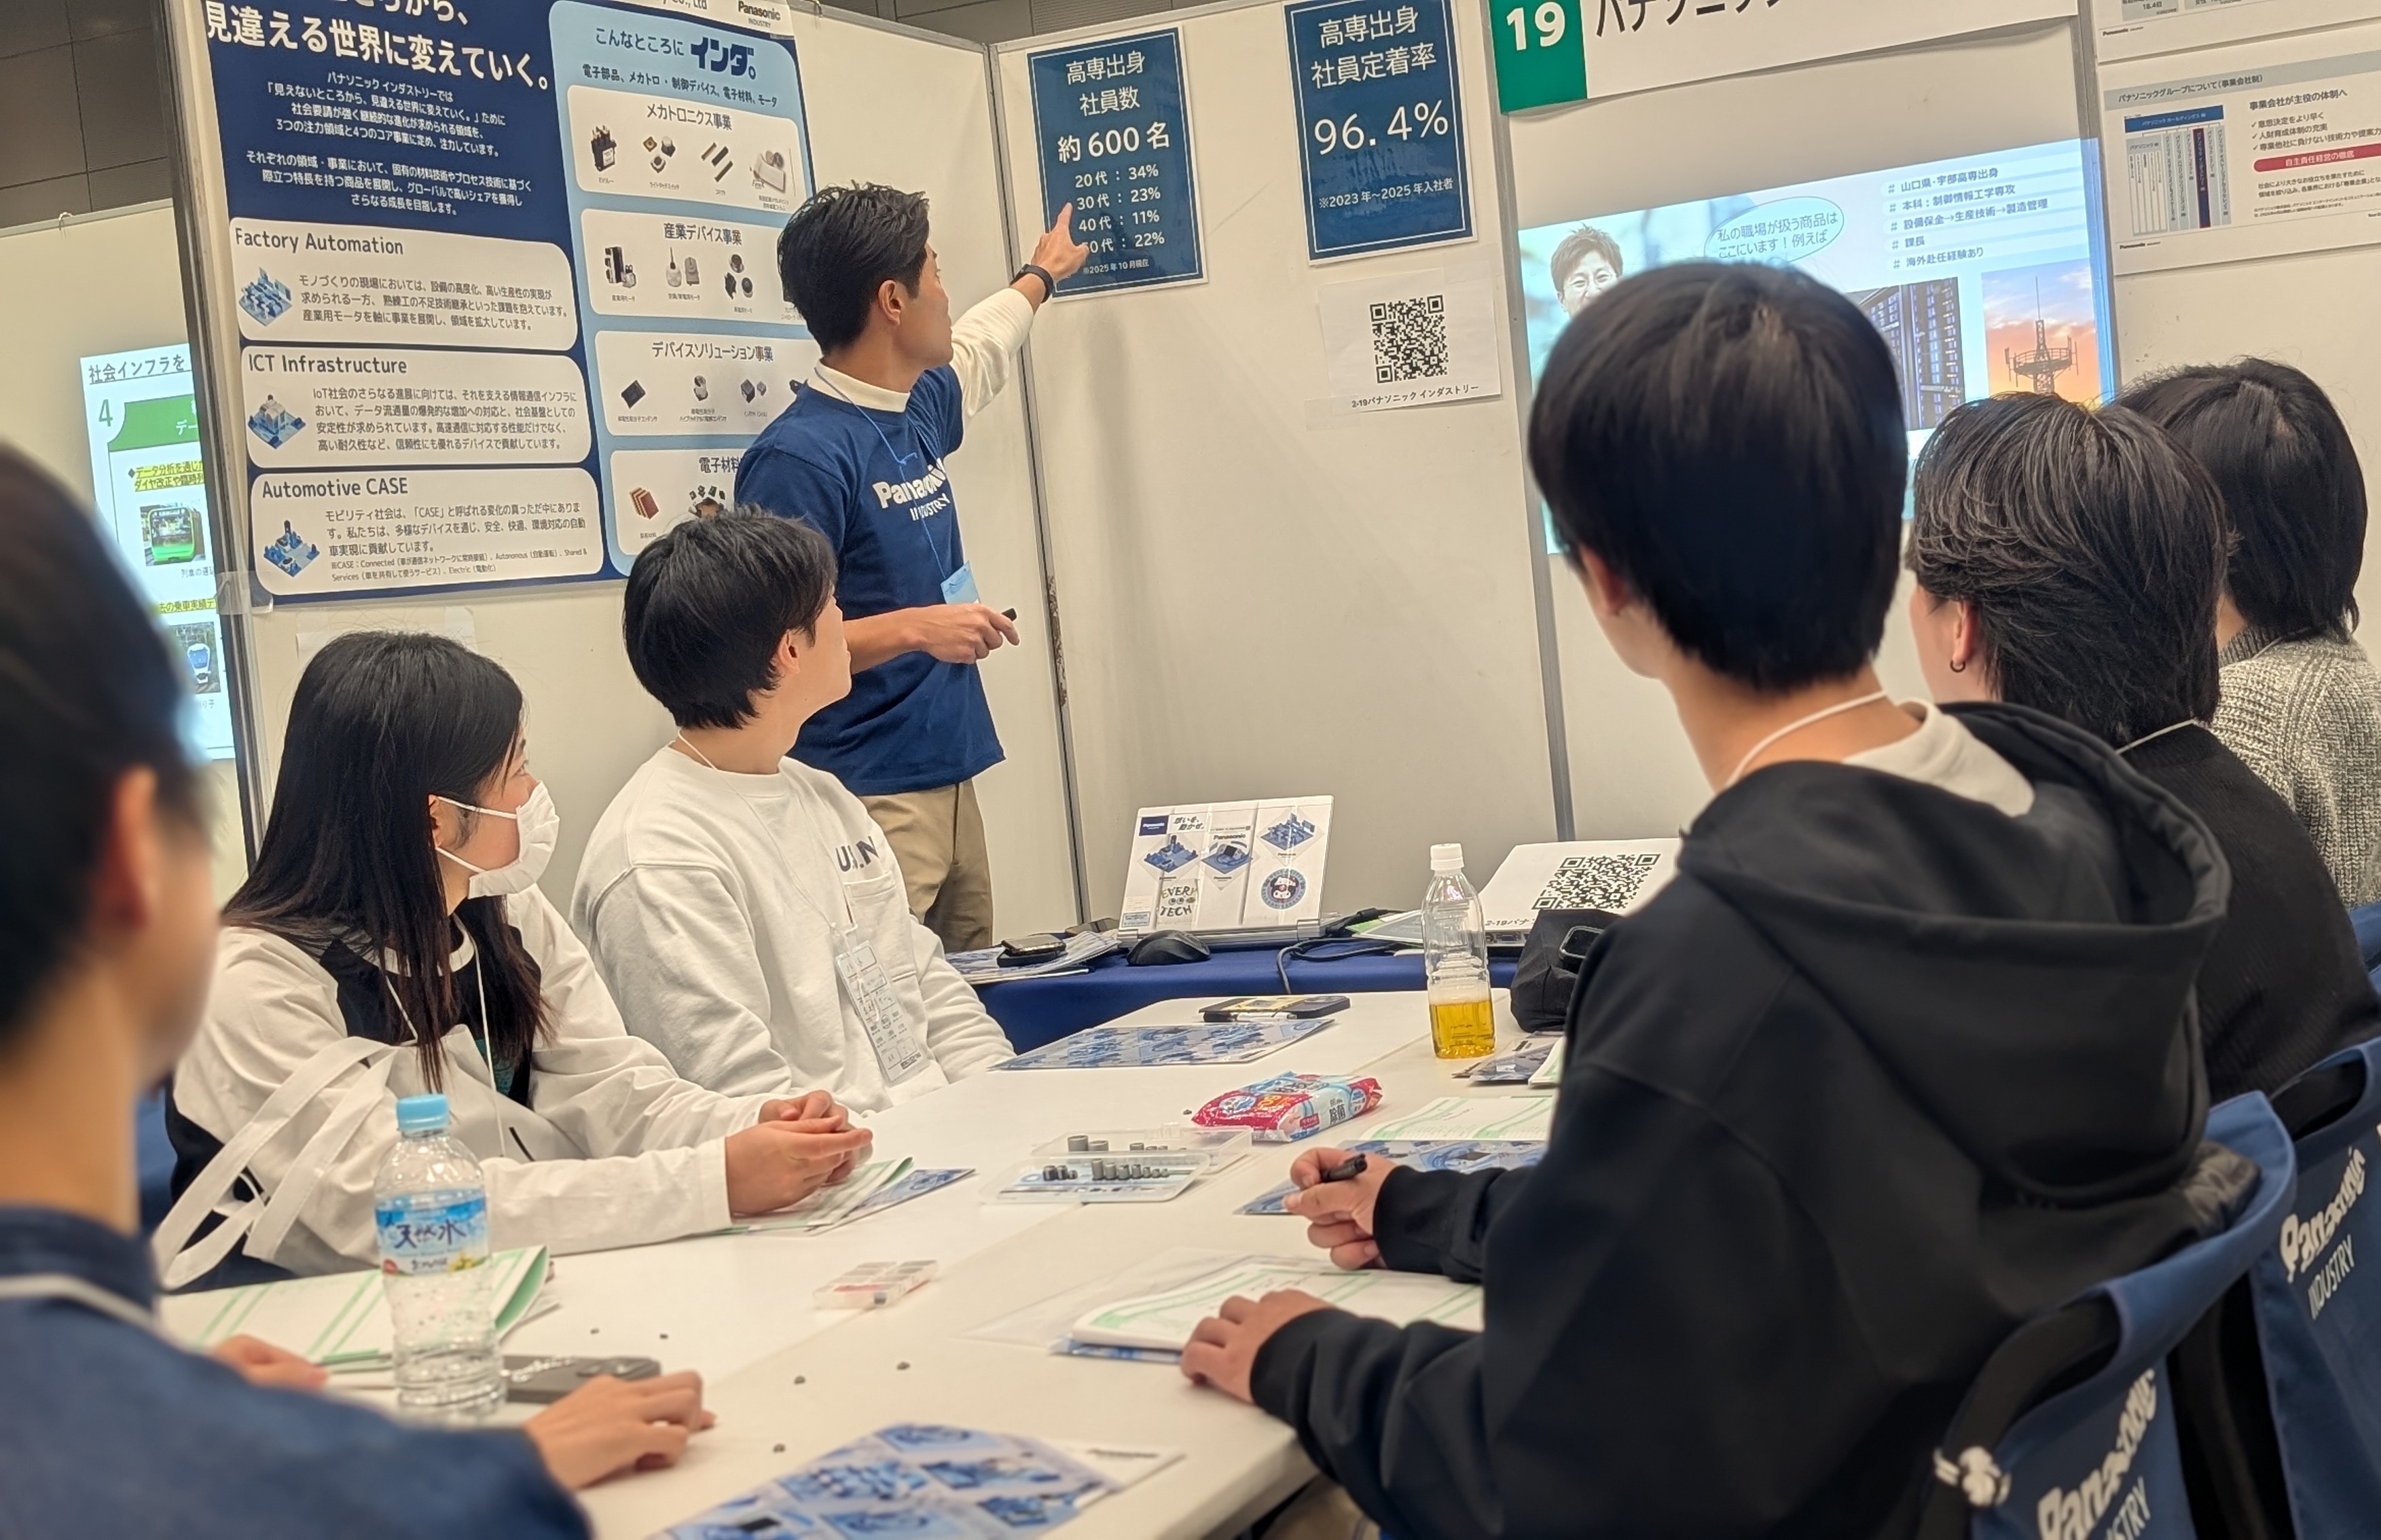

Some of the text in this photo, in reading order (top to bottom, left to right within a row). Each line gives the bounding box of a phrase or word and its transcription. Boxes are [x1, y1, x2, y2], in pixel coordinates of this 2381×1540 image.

[738, 1, 781, 20] Panasonic
[1319, 5, 1419, 48] 高専出身
[1506, 1, 1565, 51] 19
[205, 1, 548, 90] 見違える世界に変えていく。
[596, 27, 685, 56] こんなところに
[1066, 50, 1146, 86] 高専出身
[1311, 43, 1437, 89] 社員定着率
[1079, 86, 1141, 117] 社員数
[647, 104, 733, 131] メカトロニクス事業
[235, 227, 404, 255] Factory Automation
[664, 222, 742, 246] 産業デバイス事業
[1717, 212, 1838, 242] 私の職場が扱う商品は
[249, 354, 407, 374] ICT Infrastructure
[652, 341, 774, 363] デバイスソリューション事業
[88, 354, 185, 384] 社会インフラを
[98, 399, 113, 426] 4
[262, 477, 409, 498] Automotive CASE
[1160, 905, 1193, 917] TECH
[393, 1220, 467, 1249] 天然水
